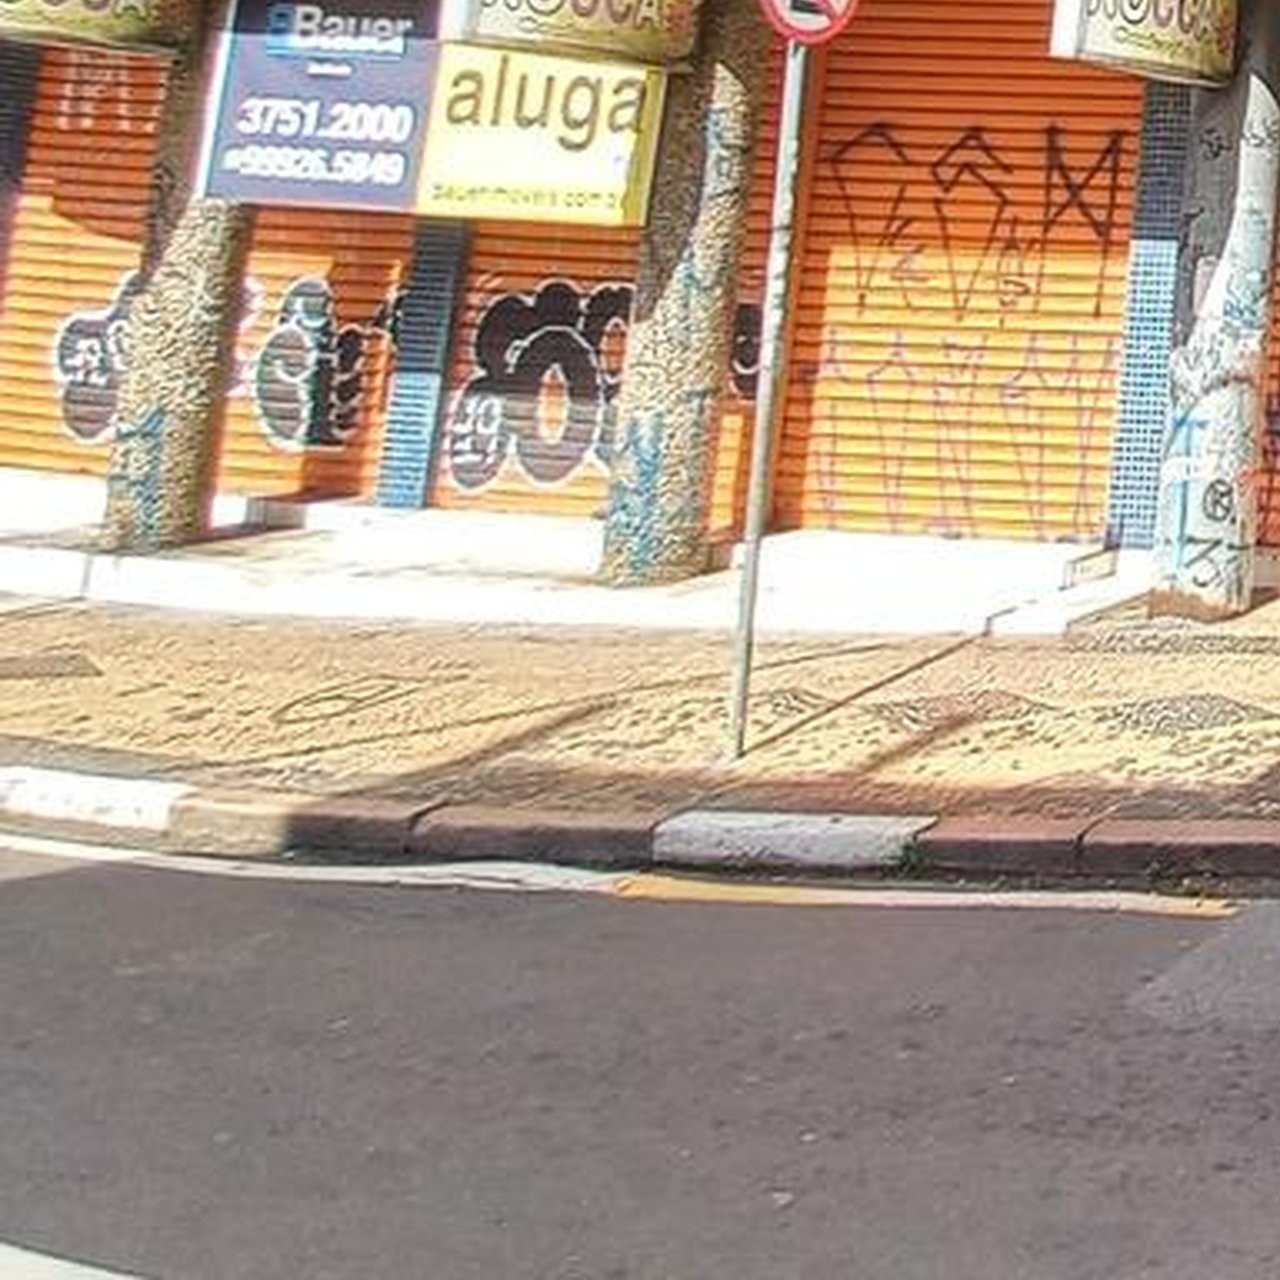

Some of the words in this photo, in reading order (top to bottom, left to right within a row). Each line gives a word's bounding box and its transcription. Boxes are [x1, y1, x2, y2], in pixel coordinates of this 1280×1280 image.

[294, 4, 414, 54] Bauer
[237, 96, 415, 144] 3751.2000
[446, 55, 649, 152] aluga
